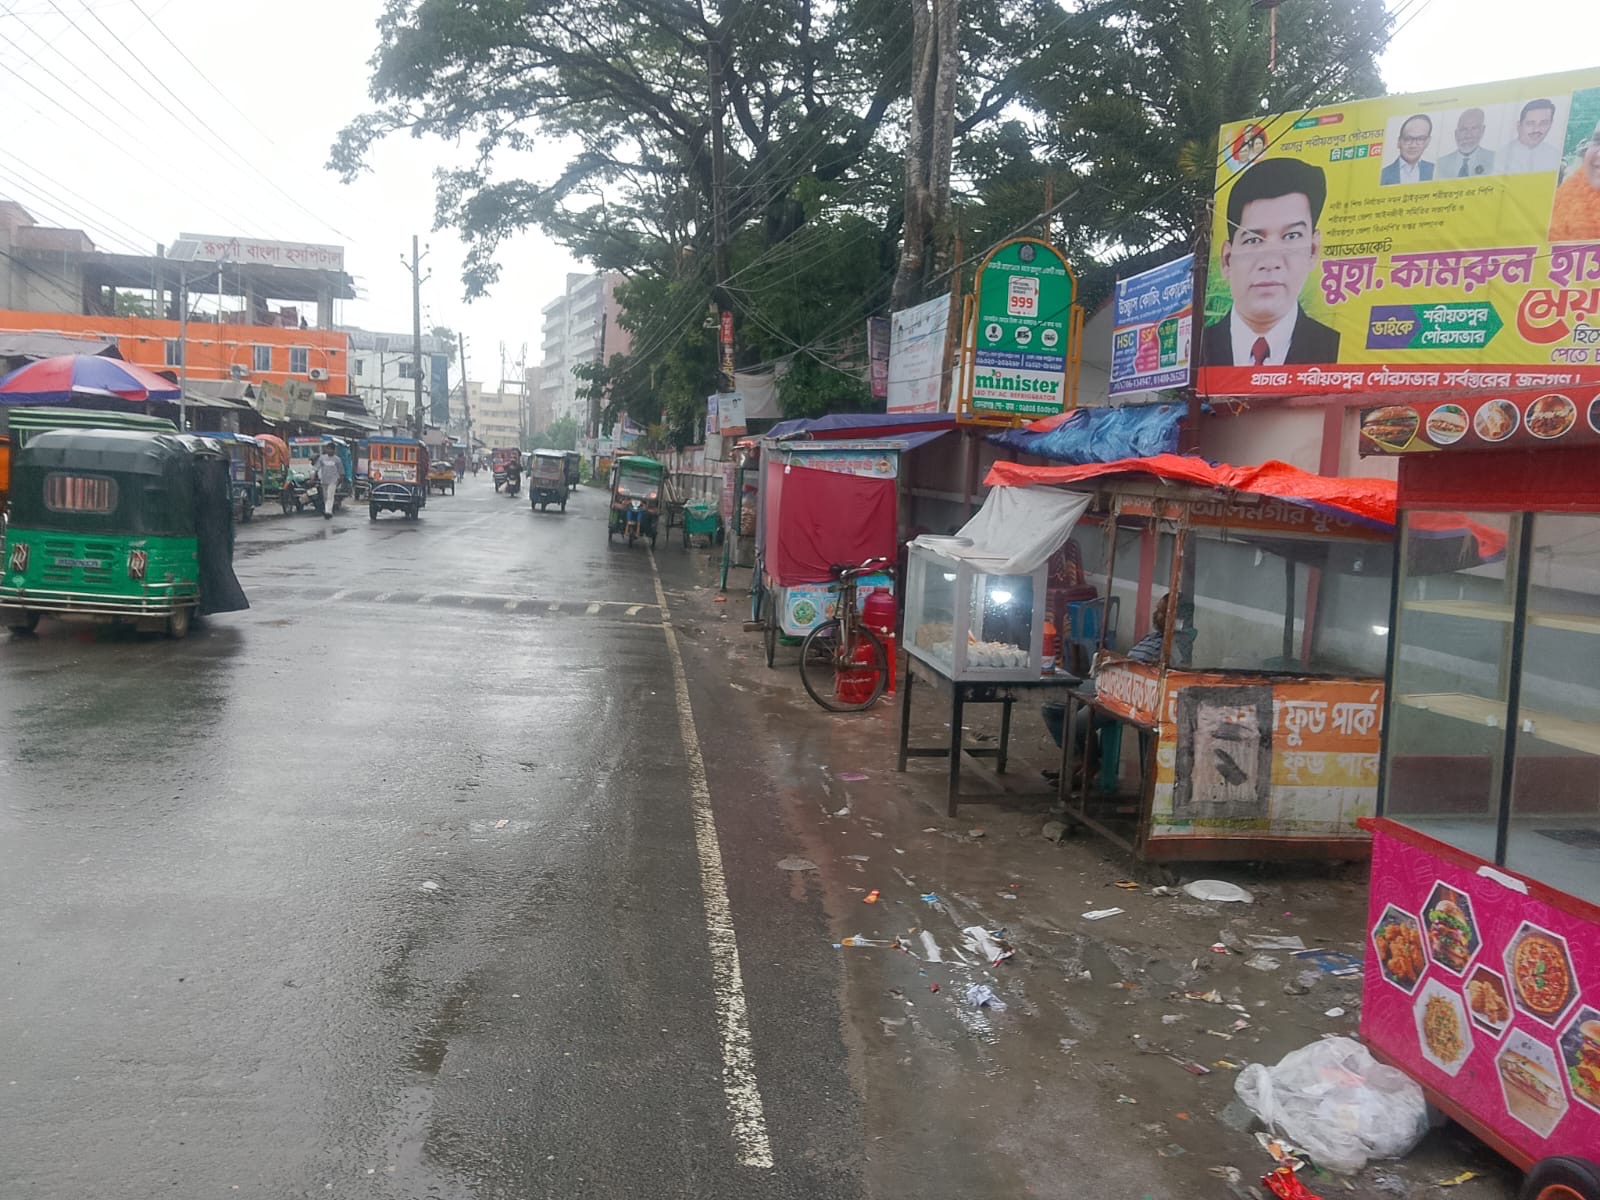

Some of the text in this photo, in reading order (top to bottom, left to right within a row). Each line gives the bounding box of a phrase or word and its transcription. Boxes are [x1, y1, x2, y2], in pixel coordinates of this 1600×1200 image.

[246, 244, 280, 261] বাংলা
[1324, 238, 1392, 256] অ্যাডভোকেট
[1320, 256, 1385, 305] মুহা.
[1390, 246, 1538, 294] কামরুল
[1011, 296, 1033, 309] 999
[1423, 305, 1489, 327] শরীয়তপুর
[1370, 317, 1415, 337] ভাইকে
[1421, 324, 1487, 344] পৌরসভার
[1117, 333, 1134, 349] HSC
[1551, 347, 1589, 363] পেতে
[976, 369, 1059, 394] minister
[1297, 366, 1365, 389] শরীয়তপুর
[1367, 365, 1439, 387] পৌরসভার
[1285, 700, 1328, 746] ফুড
[1332, 689, 1380, 735] পার্ক
